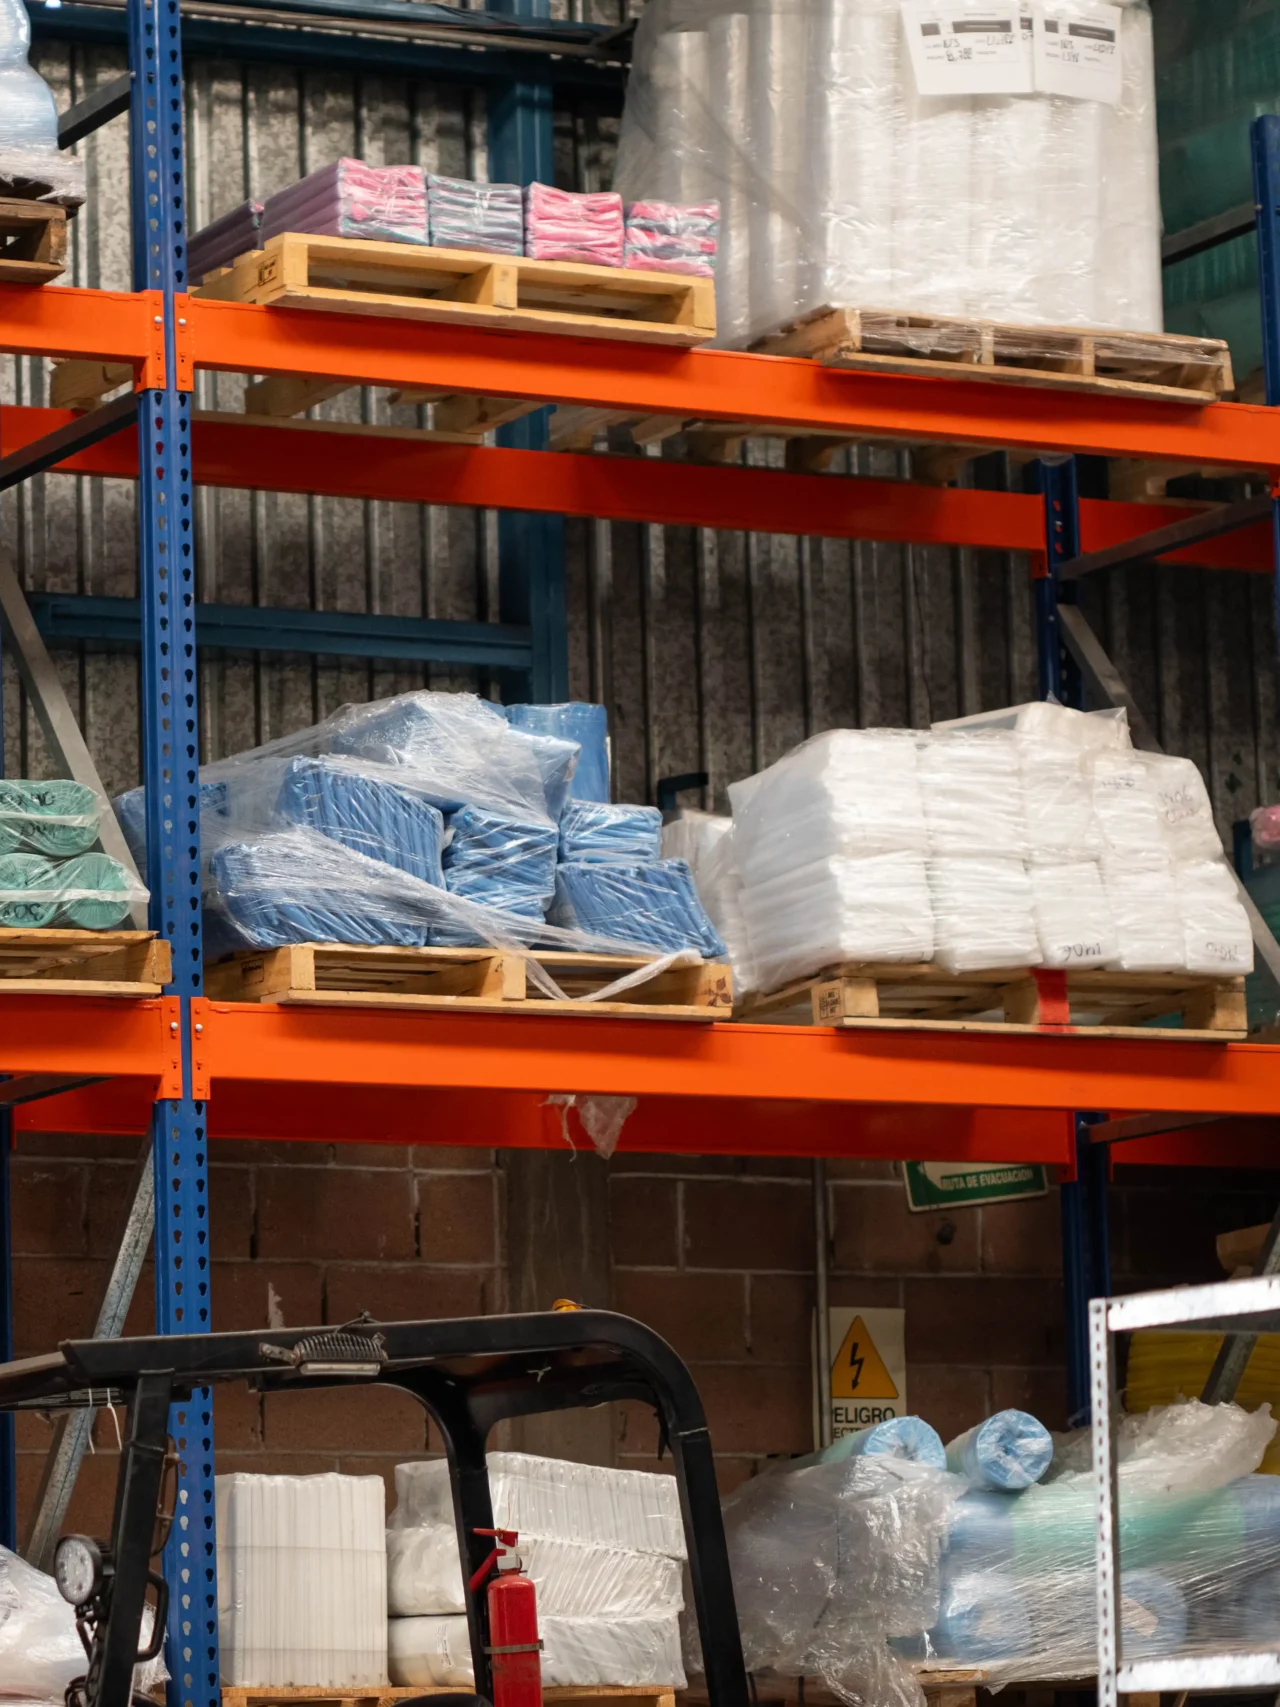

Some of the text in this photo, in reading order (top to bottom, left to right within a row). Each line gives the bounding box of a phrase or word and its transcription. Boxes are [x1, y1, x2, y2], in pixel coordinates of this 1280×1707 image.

[941, 1176, 966, 1191] RUTA
[966, 1174, 979, 1188] DE
[832, 1406, 896, 1424] ELIGRO
